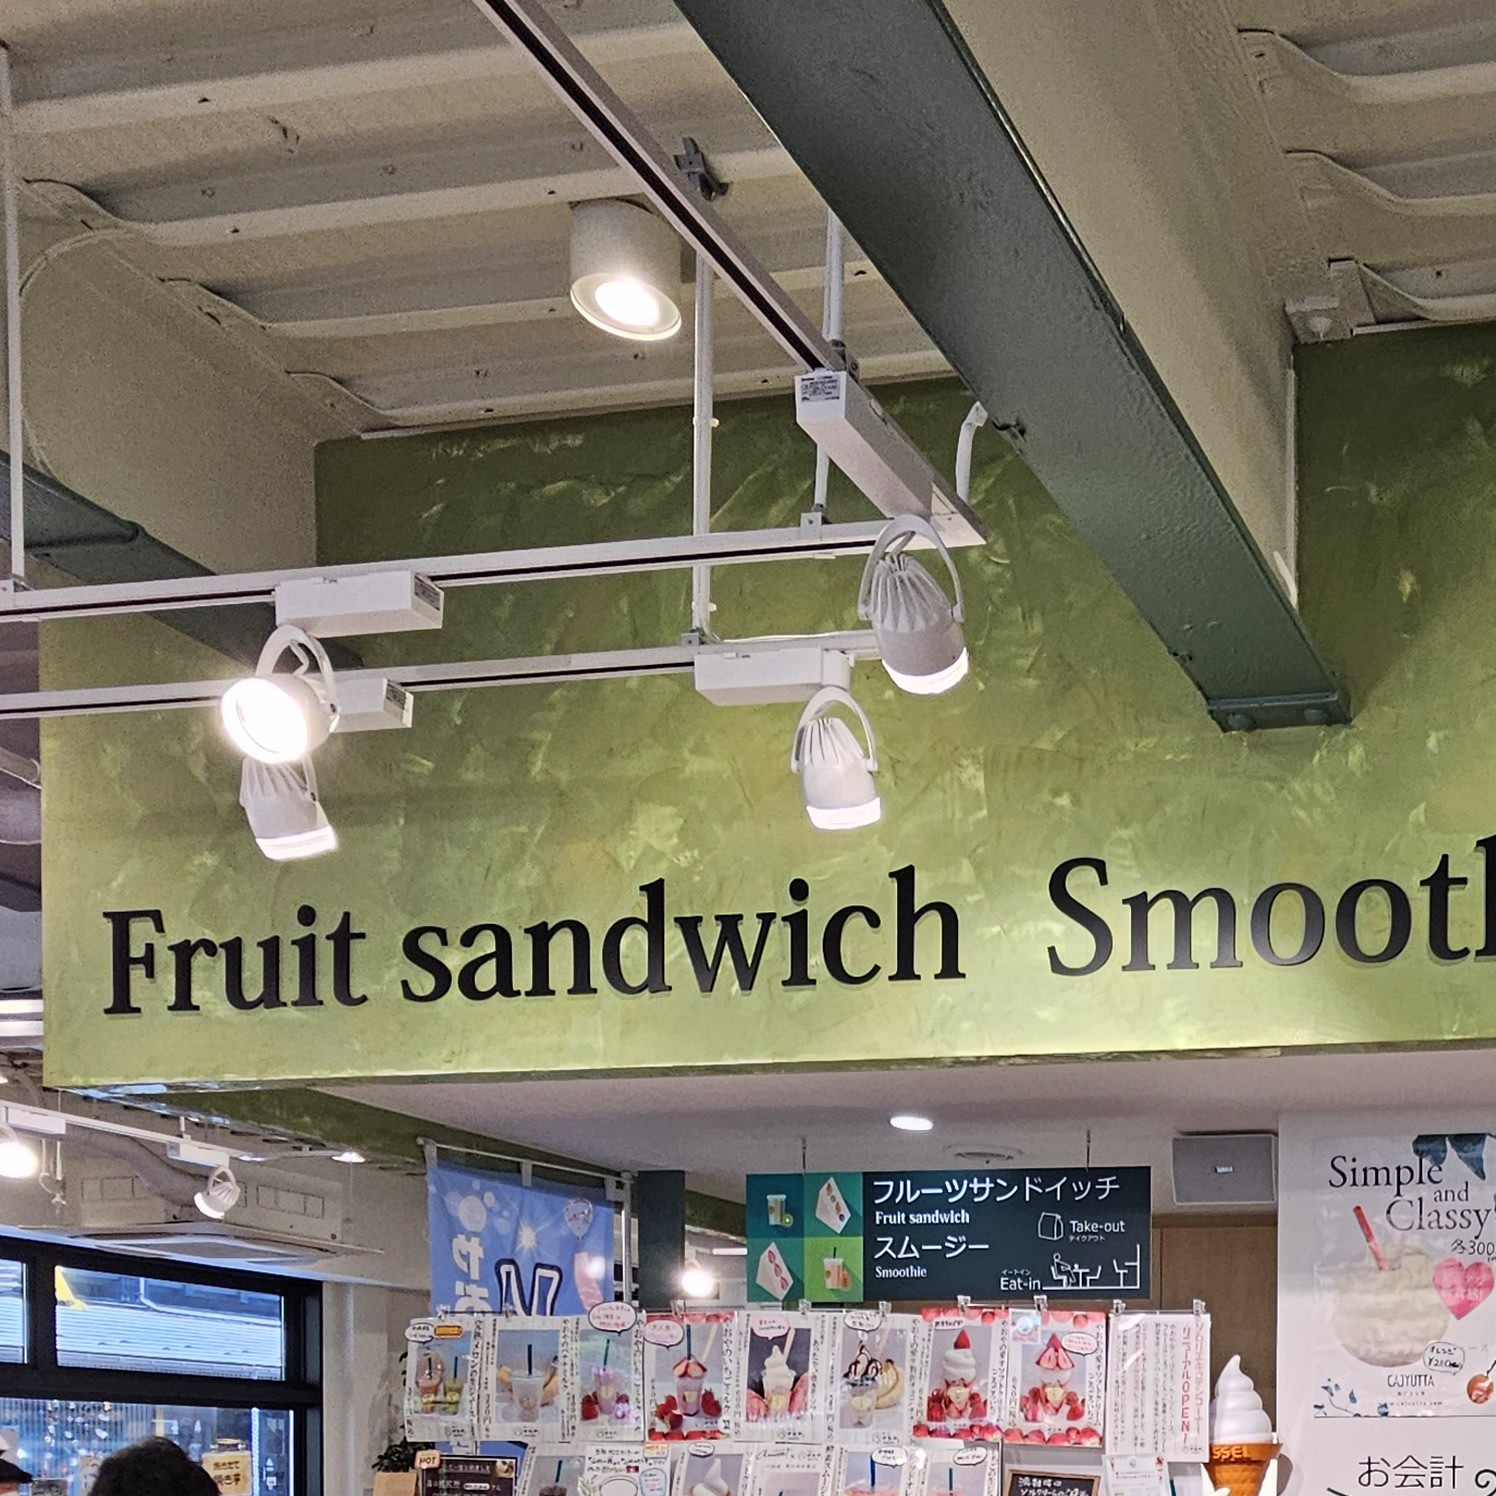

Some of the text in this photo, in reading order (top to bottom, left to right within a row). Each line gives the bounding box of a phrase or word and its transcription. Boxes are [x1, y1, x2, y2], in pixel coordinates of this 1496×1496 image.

[103, 904, 367, 1014] Fruit
[400, 865, 966, 1002] sandwich
[873, 1176, 1120, 1204] フルーツサンドイッチ
[1328, 1153, 1493, 1240] Simple and Classy
[875, 1209, 970, 1225] Fruit sandwich
[1069, 1220, 1126, 1233] Take-out
[874, 1235, 989, 1259] スムージー
[875, 1265, 928, 1279] Smoothie
[1000, 1277, 1041, 1291] Eat-in
[419, 1456, 436, 1464] HOT
[1358, 1455, 1464, 1489] お会計
